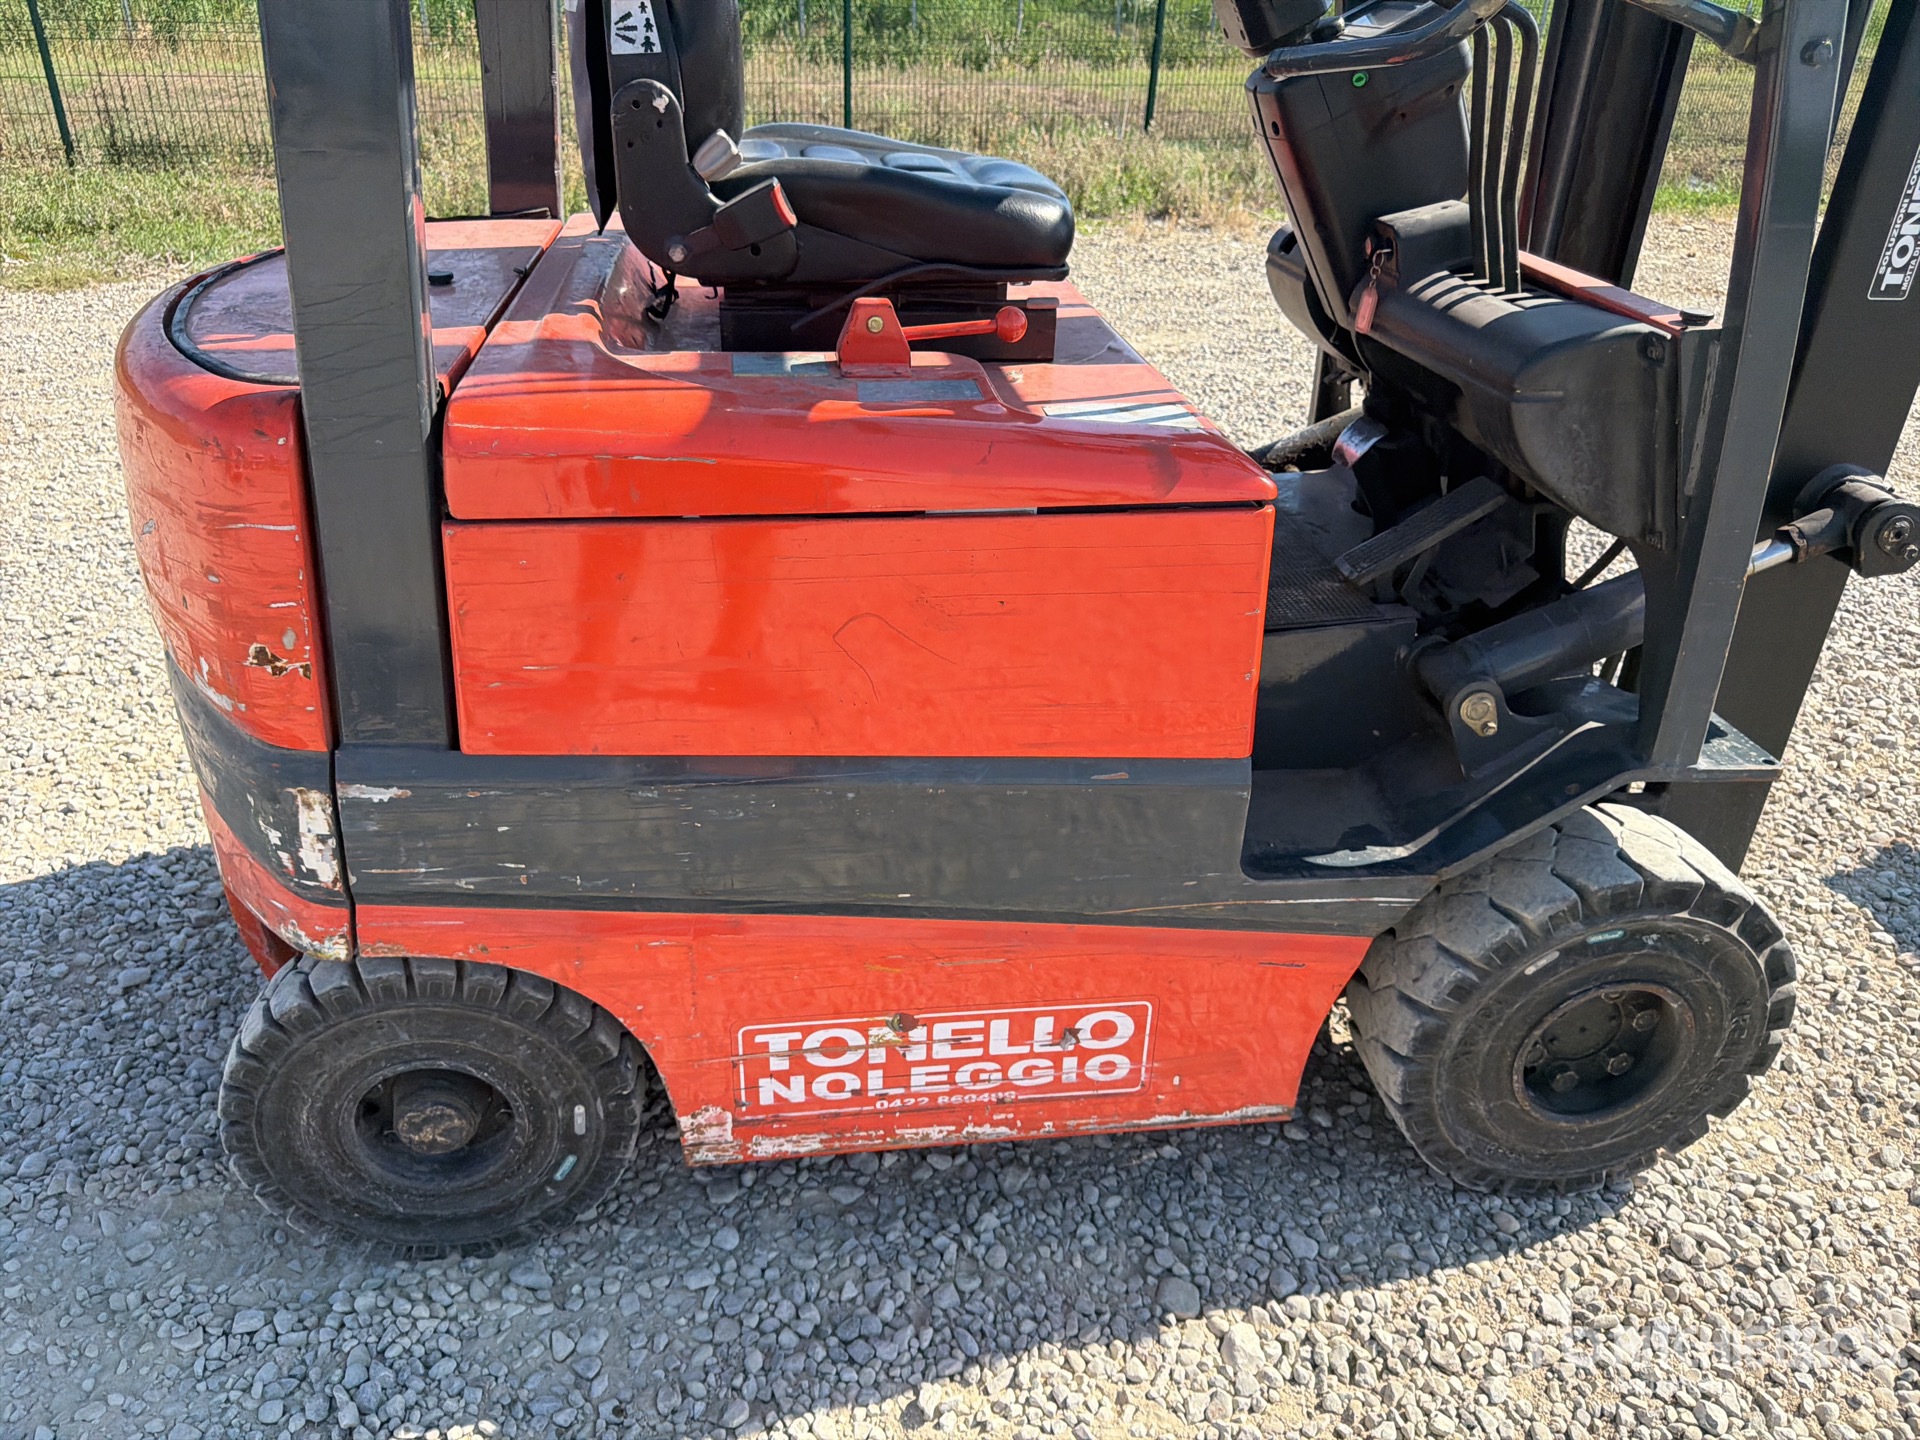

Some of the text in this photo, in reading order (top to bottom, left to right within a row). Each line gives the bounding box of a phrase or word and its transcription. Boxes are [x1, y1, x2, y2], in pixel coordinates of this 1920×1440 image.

[1879, 198, 1910, 274] SOLUZIONI
[1901, 259, 1917, 290] MOTTA
[754, 1011, 1135, 1071] TONELLO
[758, 1054, 1132, 1106] NOLEGGIO
[875, 1096, 929, 1110] 0422
